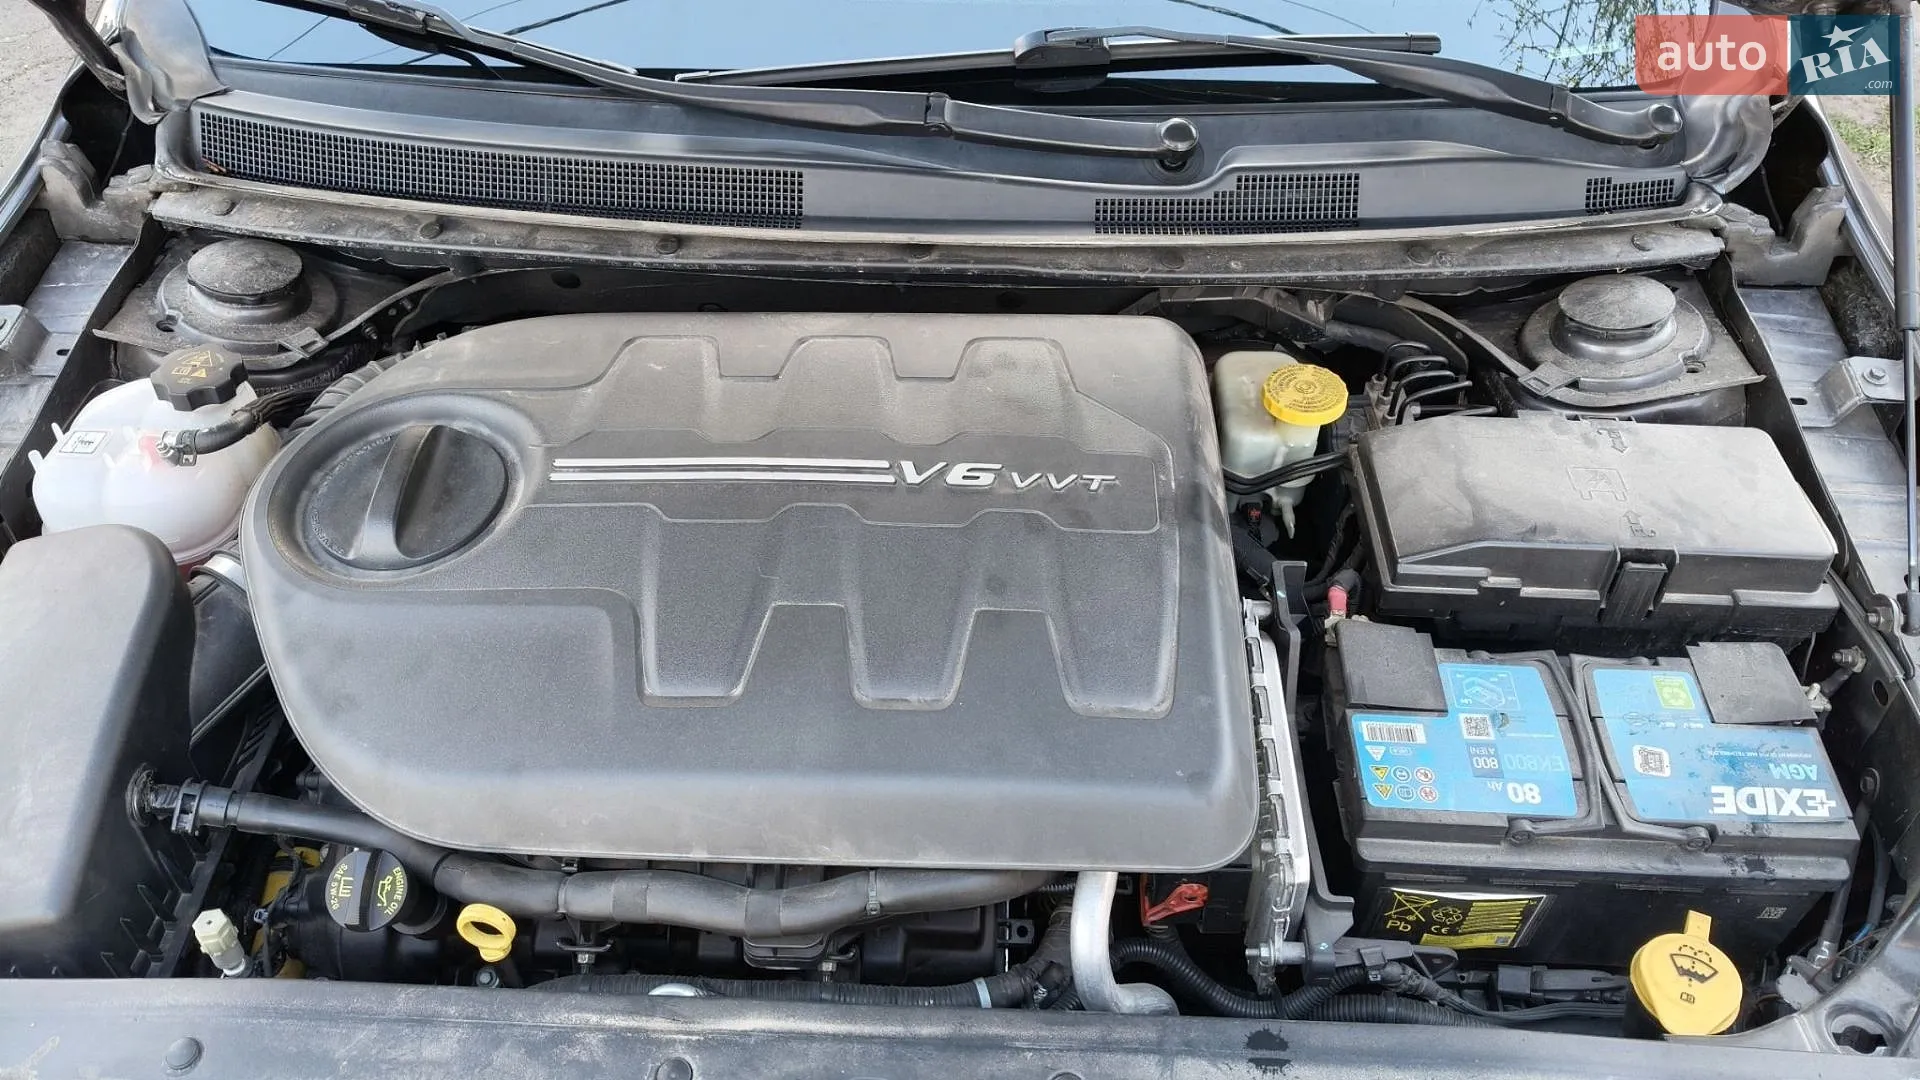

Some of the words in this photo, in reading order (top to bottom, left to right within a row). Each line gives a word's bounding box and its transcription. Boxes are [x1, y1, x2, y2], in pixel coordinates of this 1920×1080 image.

[900, 460, 1003, 488] V6
[1011, 471, 1117, 492] VVT
[1472, 755, 1499, 769] 800
[1503, 753, 1565, 772] EK800
[1768, 763, 1818, 781] AGM
[1487, 780, 1504, 792] Ah
[1506, 781, 1542, 805] 80
[1711, 784, 1836, 817] EXIDE
[333, 863, 348, 879] SAE
[393, 866, 405, 901] ENGINE
[384, 902, 398, 916] OIL
[1386, 919, 1412, 932] Pb
